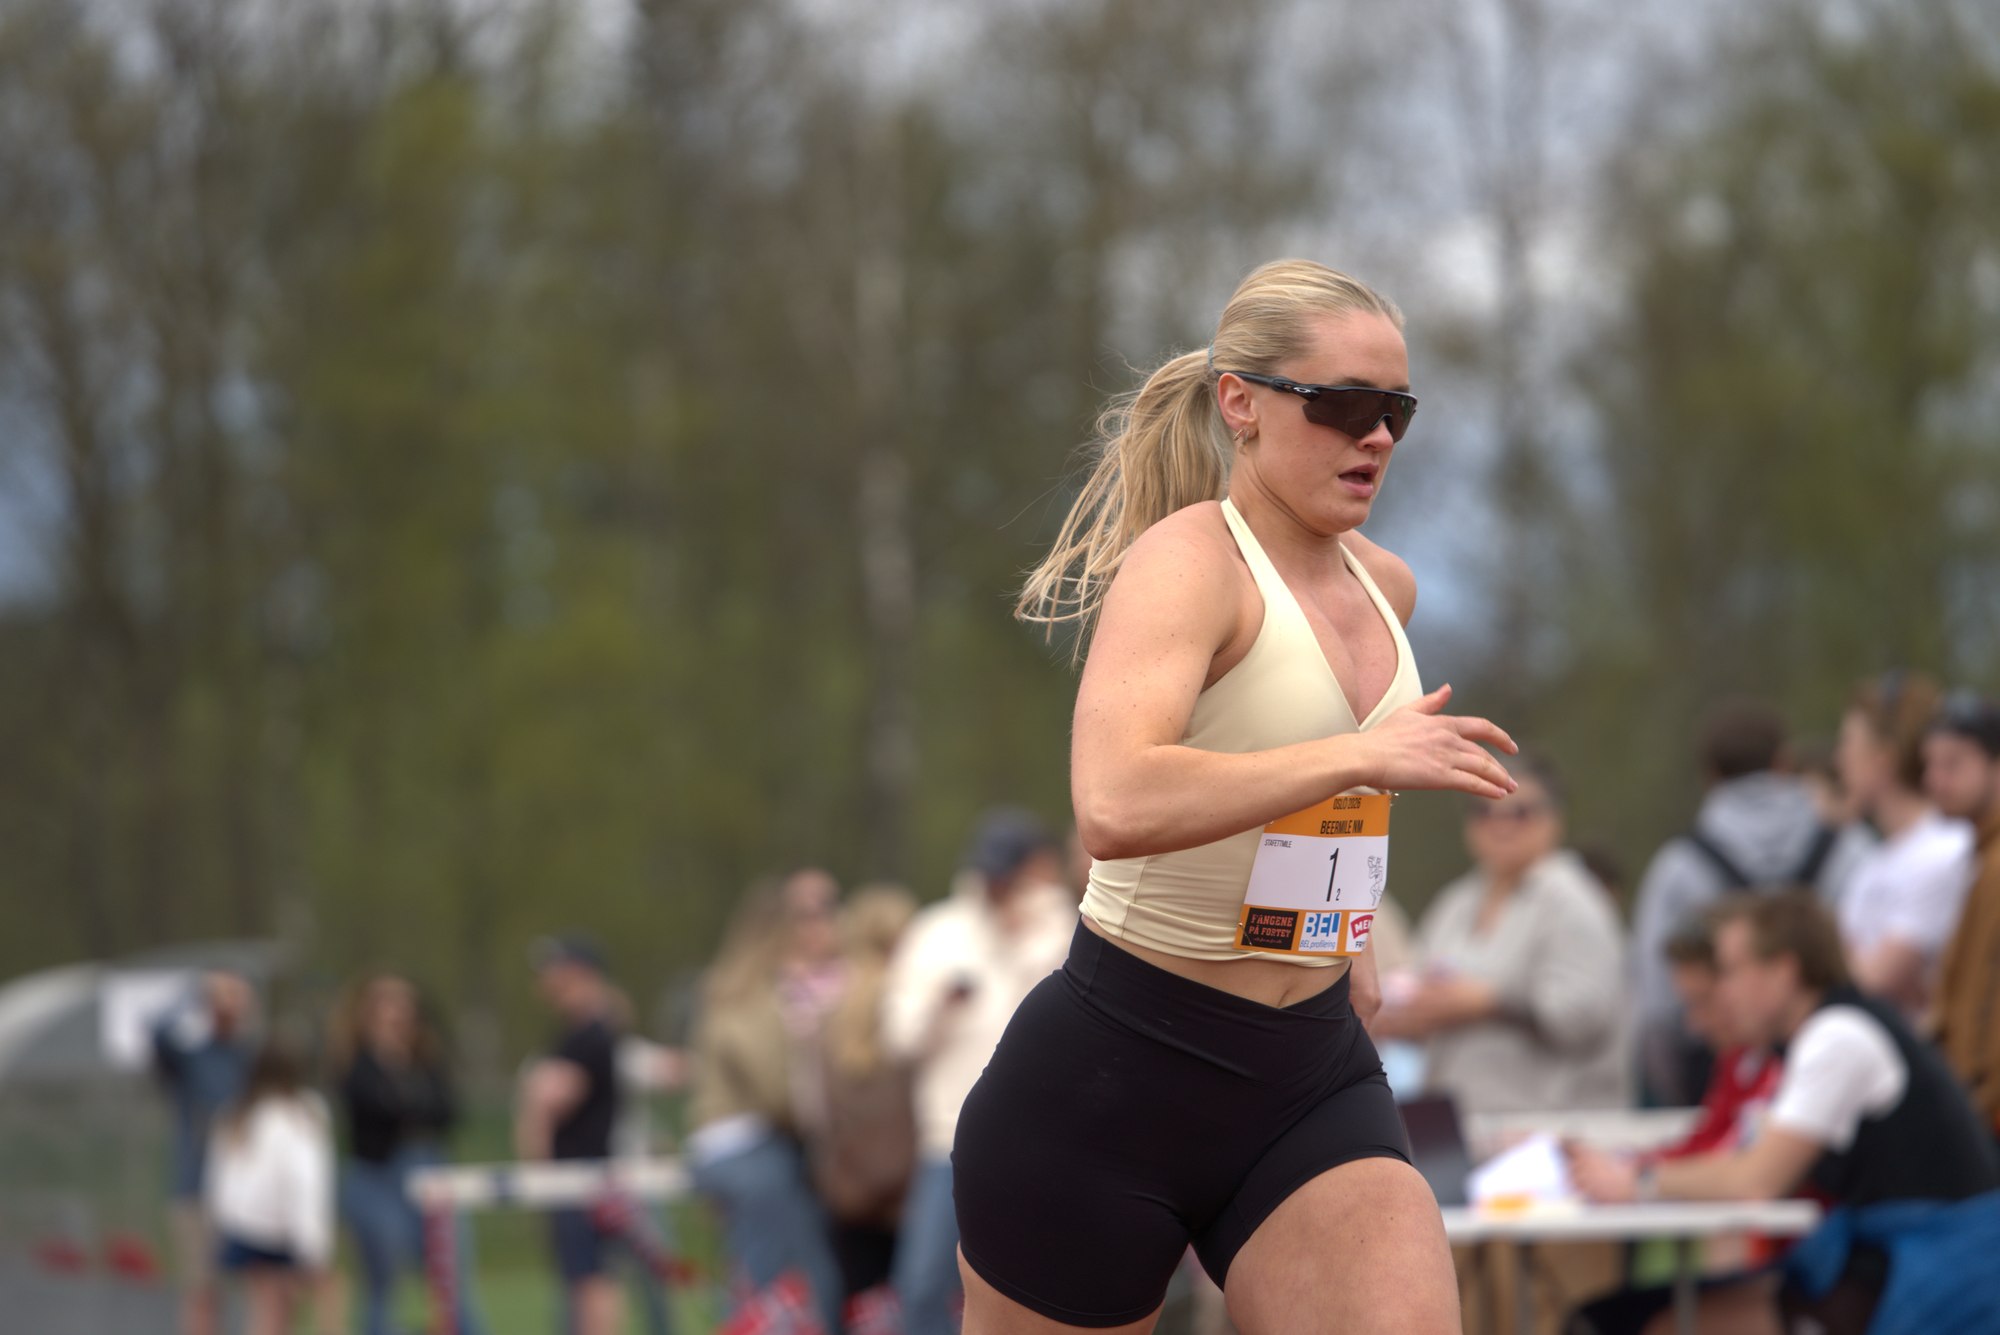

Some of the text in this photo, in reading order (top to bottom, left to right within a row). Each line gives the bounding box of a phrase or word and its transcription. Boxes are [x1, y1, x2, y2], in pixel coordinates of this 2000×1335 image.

[1333, 798, 1347, 809] OSLO
[1320, 819, 1364, 834] BEERMILE NM
[1326, 848, 1339, 902] 1
[1336, 888, 1341, 901] 2
[1306, 912, 1340, 937] BEL
[1261, 928, 1291, 938] FORTET
